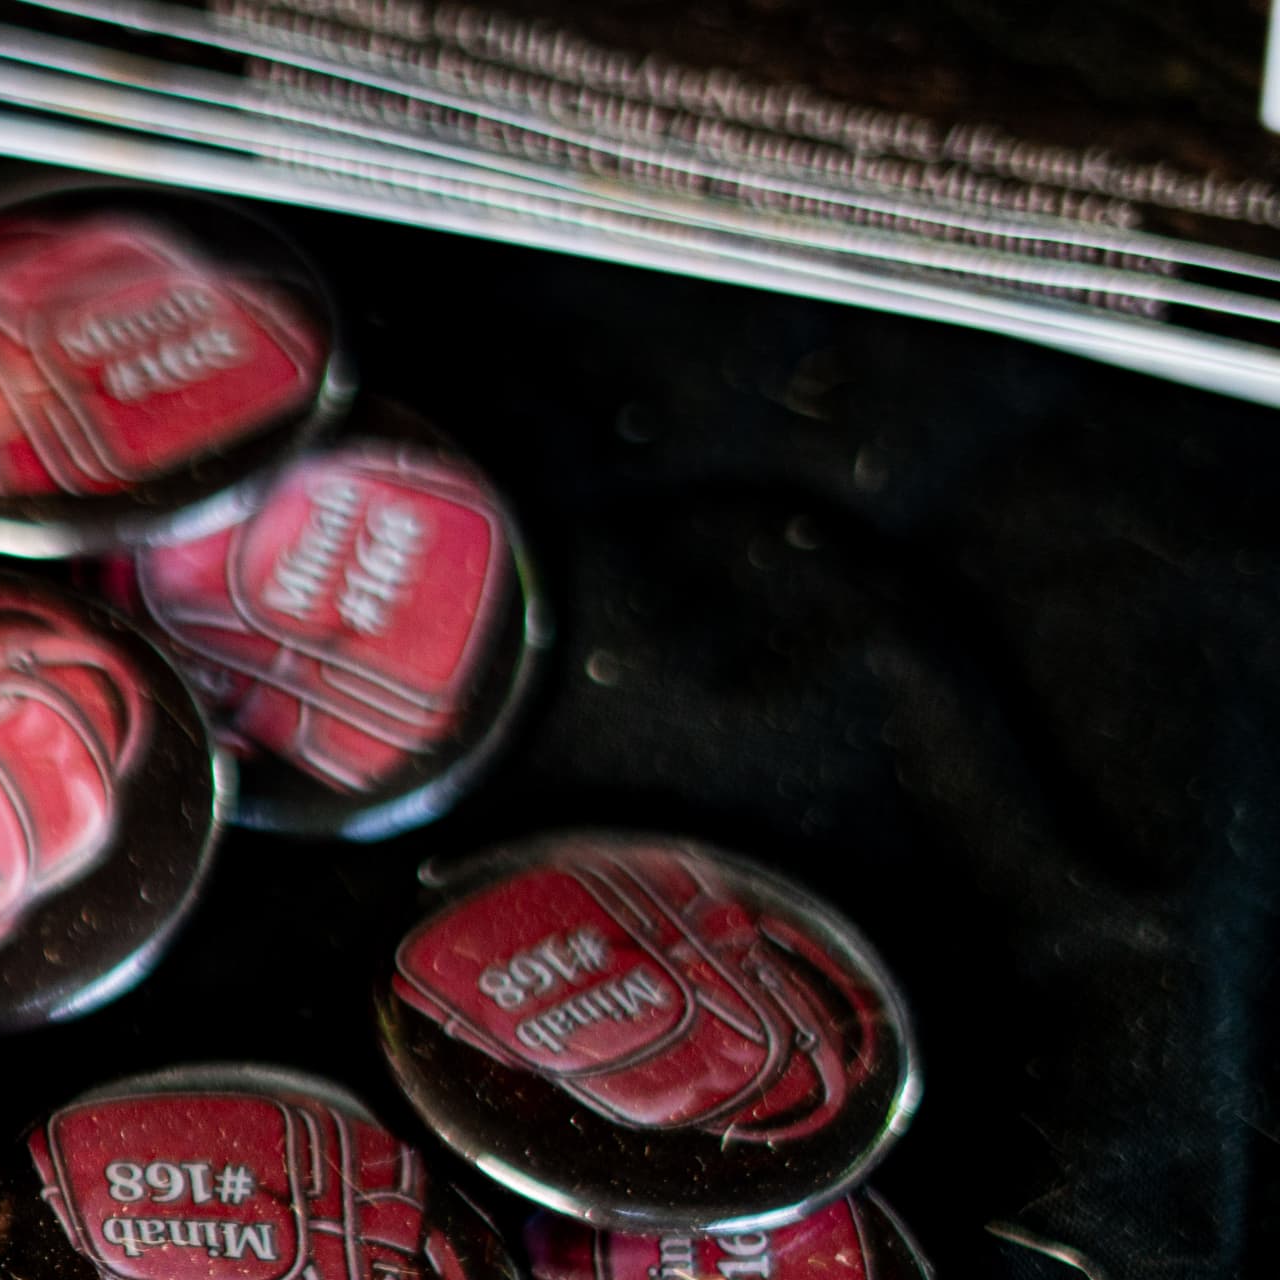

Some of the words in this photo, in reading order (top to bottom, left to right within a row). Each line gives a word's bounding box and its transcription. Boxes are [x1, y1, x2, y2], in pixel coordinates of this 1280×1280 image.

[264, 476, 360, 624] Minab
[336, 502, 424, 636] #168
[477, 930, 608, 1013] #168
[515, 965, 672, 1054] Minab
[104, 1161, 254, 1205] #168
[102, 1216, 278, 1261] Minab
